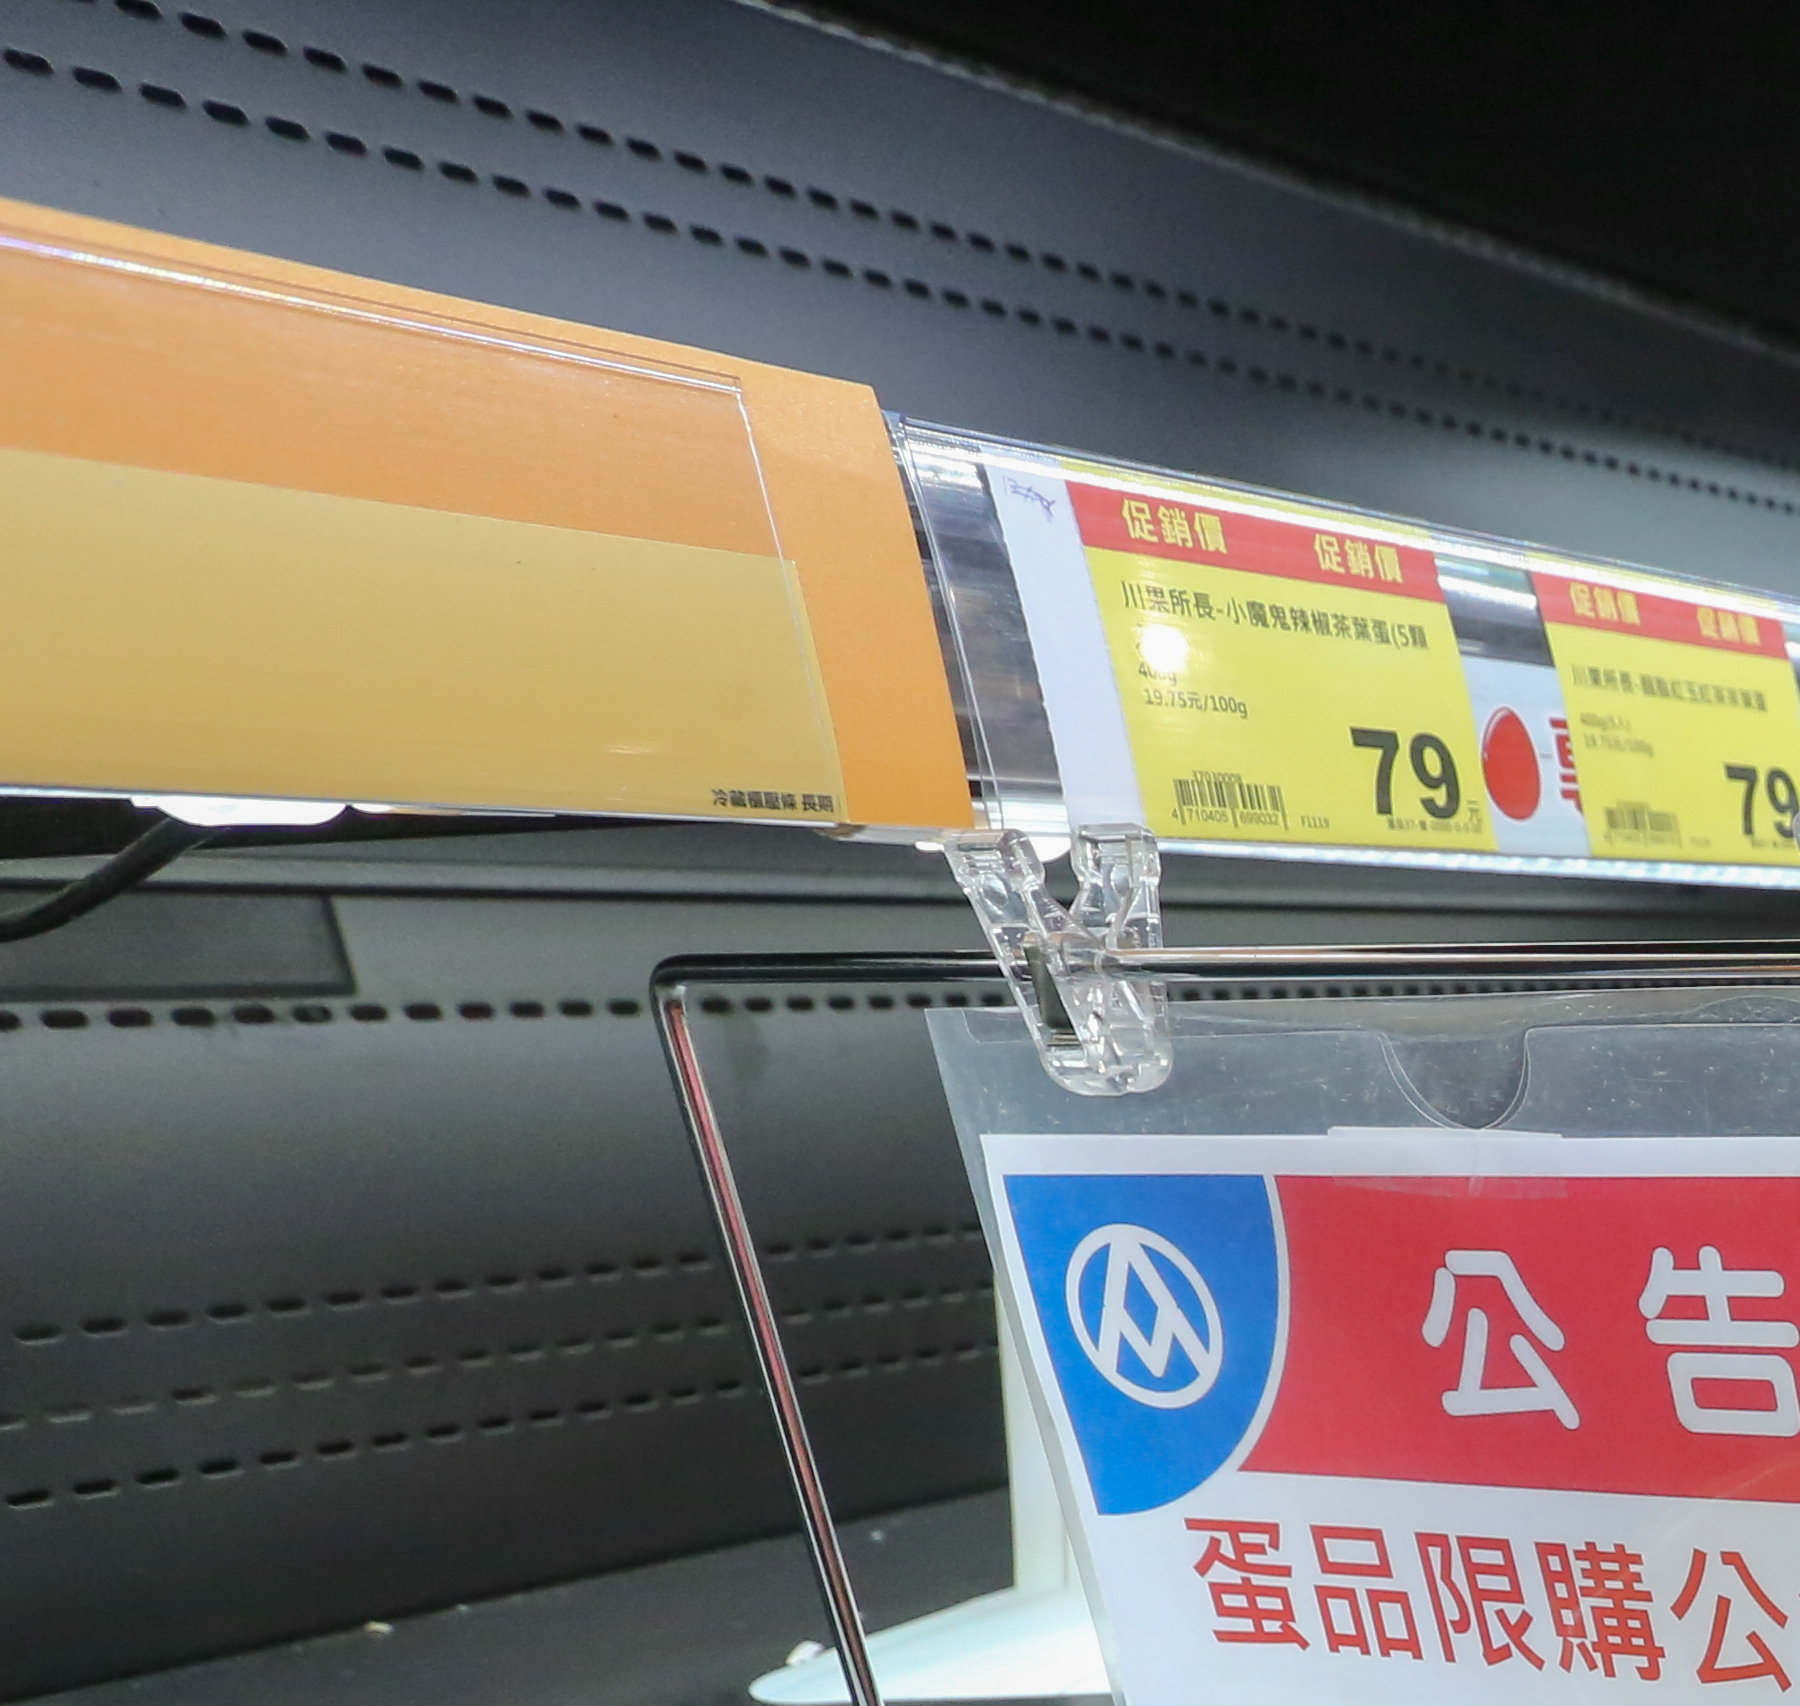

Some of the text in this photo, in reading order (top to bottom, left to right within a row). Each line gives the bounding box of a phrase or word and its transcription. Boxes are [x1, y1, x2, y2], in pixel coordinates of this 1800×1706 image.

[1121, 497, 1229, 556] 促銷價
[1313, 532, 1404, 585] 促銷價
[1349, 725, 1462, 820] 79
